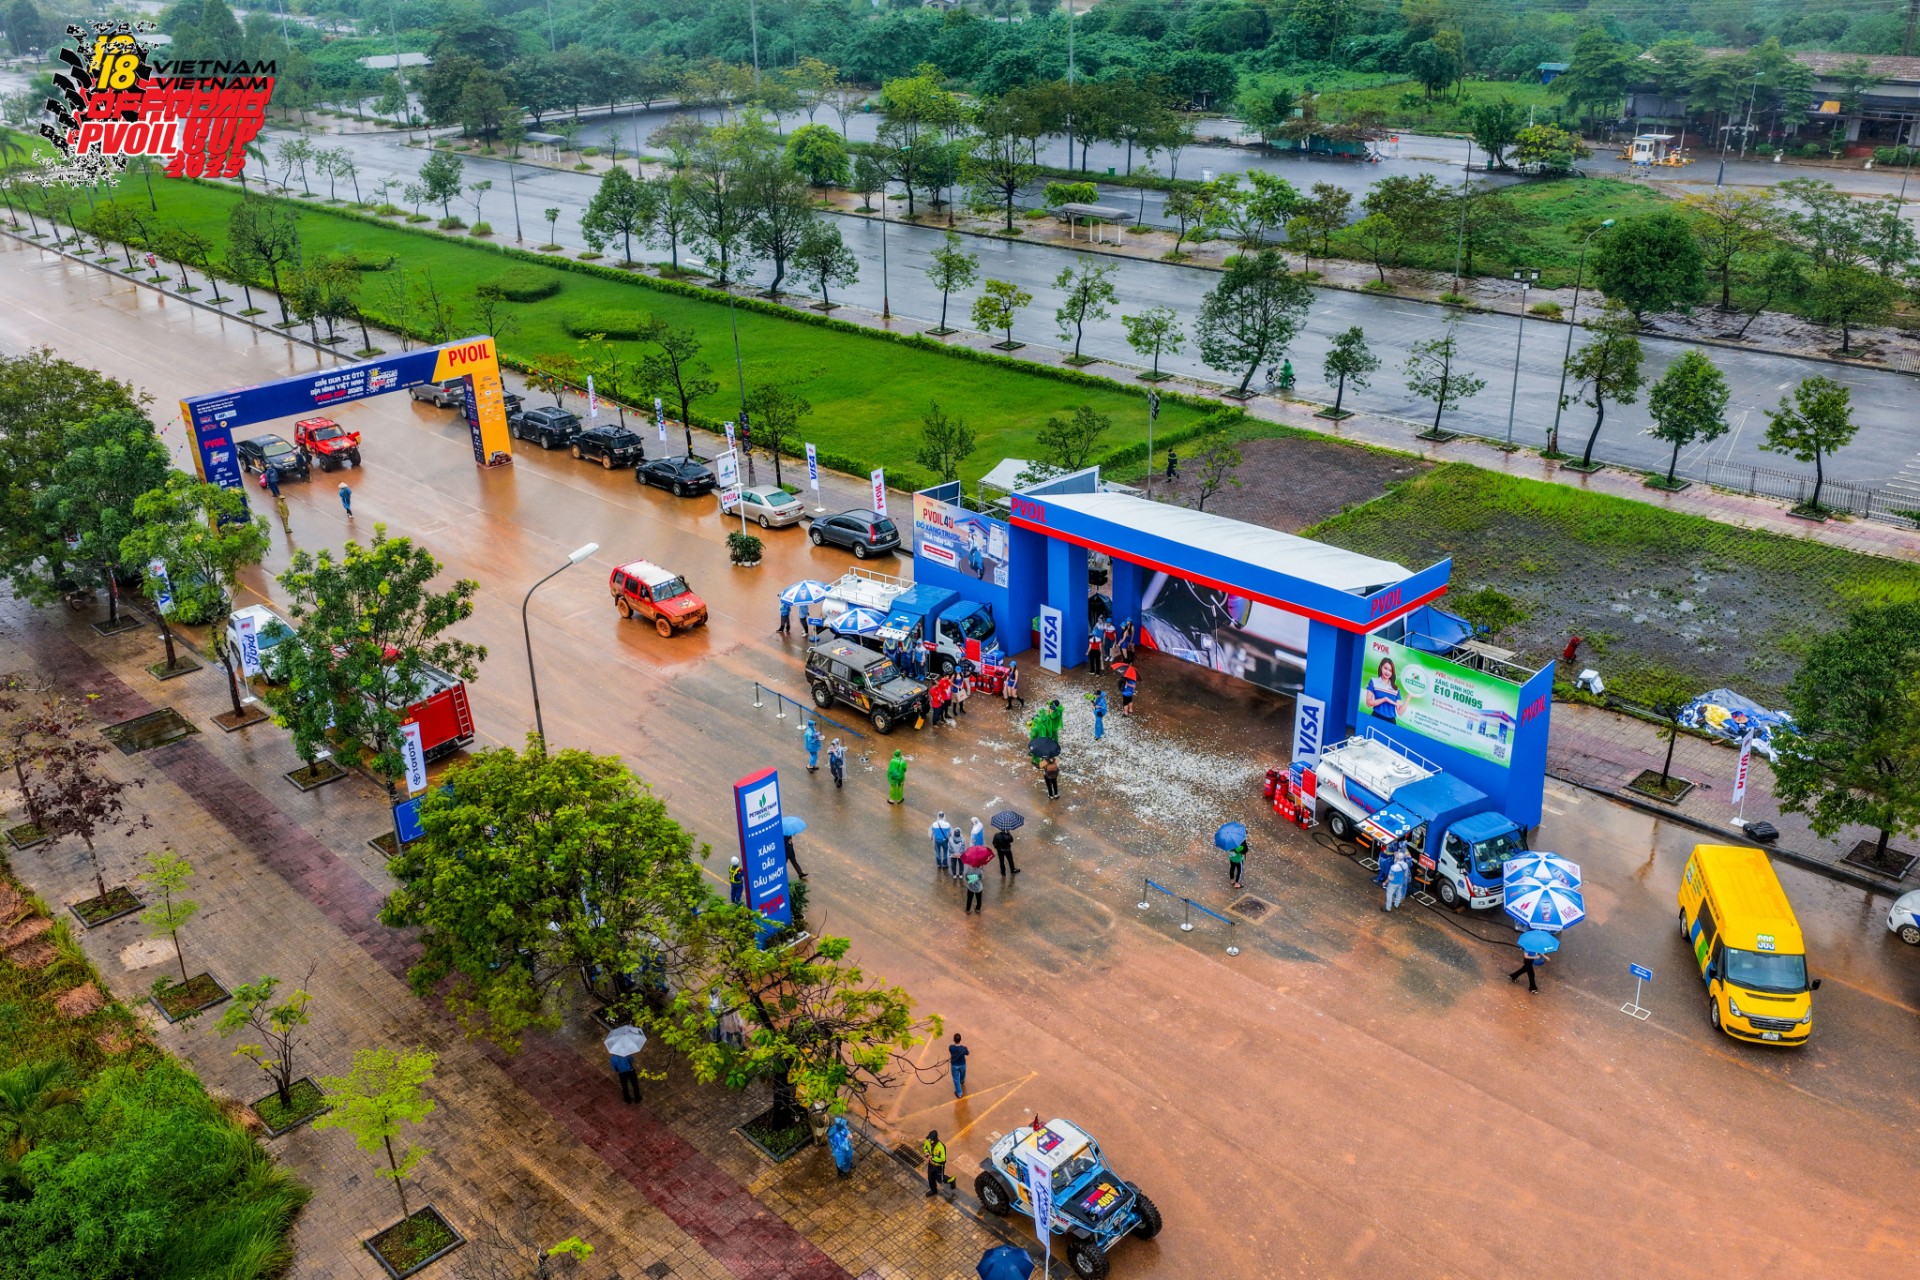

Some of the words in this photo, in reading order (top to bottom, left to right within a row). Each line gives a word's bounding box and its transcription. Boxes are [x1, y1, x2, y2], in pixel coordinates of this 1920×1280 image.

[448, 343, 490, 367] PVOIL
[204, 437, 227, 449] PVOIL
[809, 456, 817, 479] VISA
[875, 482, 884, 510] PVOIL
[923, 508, 944, 526] PVOIL
[944, 515, 954, 529] 4U
[1011, 497, 1046, 523] PVOIL
[1371, 587, 1402, 618] PVOIL
[242, 633, 258, 667] Ford
[1044, 615, 1057, 662] VISA
[1373, 641, 1389, 654] PVOIL
[1434, 685, 1450, 698] E10
[1453, 692, 1483, 710] RON95
[1521, 694, 1546, 728] PVOIL
[1298, 705, 1319, 757] VISA
[408, 740, 419, 774] TOYOTA
[757, 842, 776, 857] XĂNG
[762, 858, 775, 870] DẦU
[753, 875, 767, 888] DẦU
[769, 866, 784, 882] NHỚT
[1097, 1193, 1115, 1207] 409
